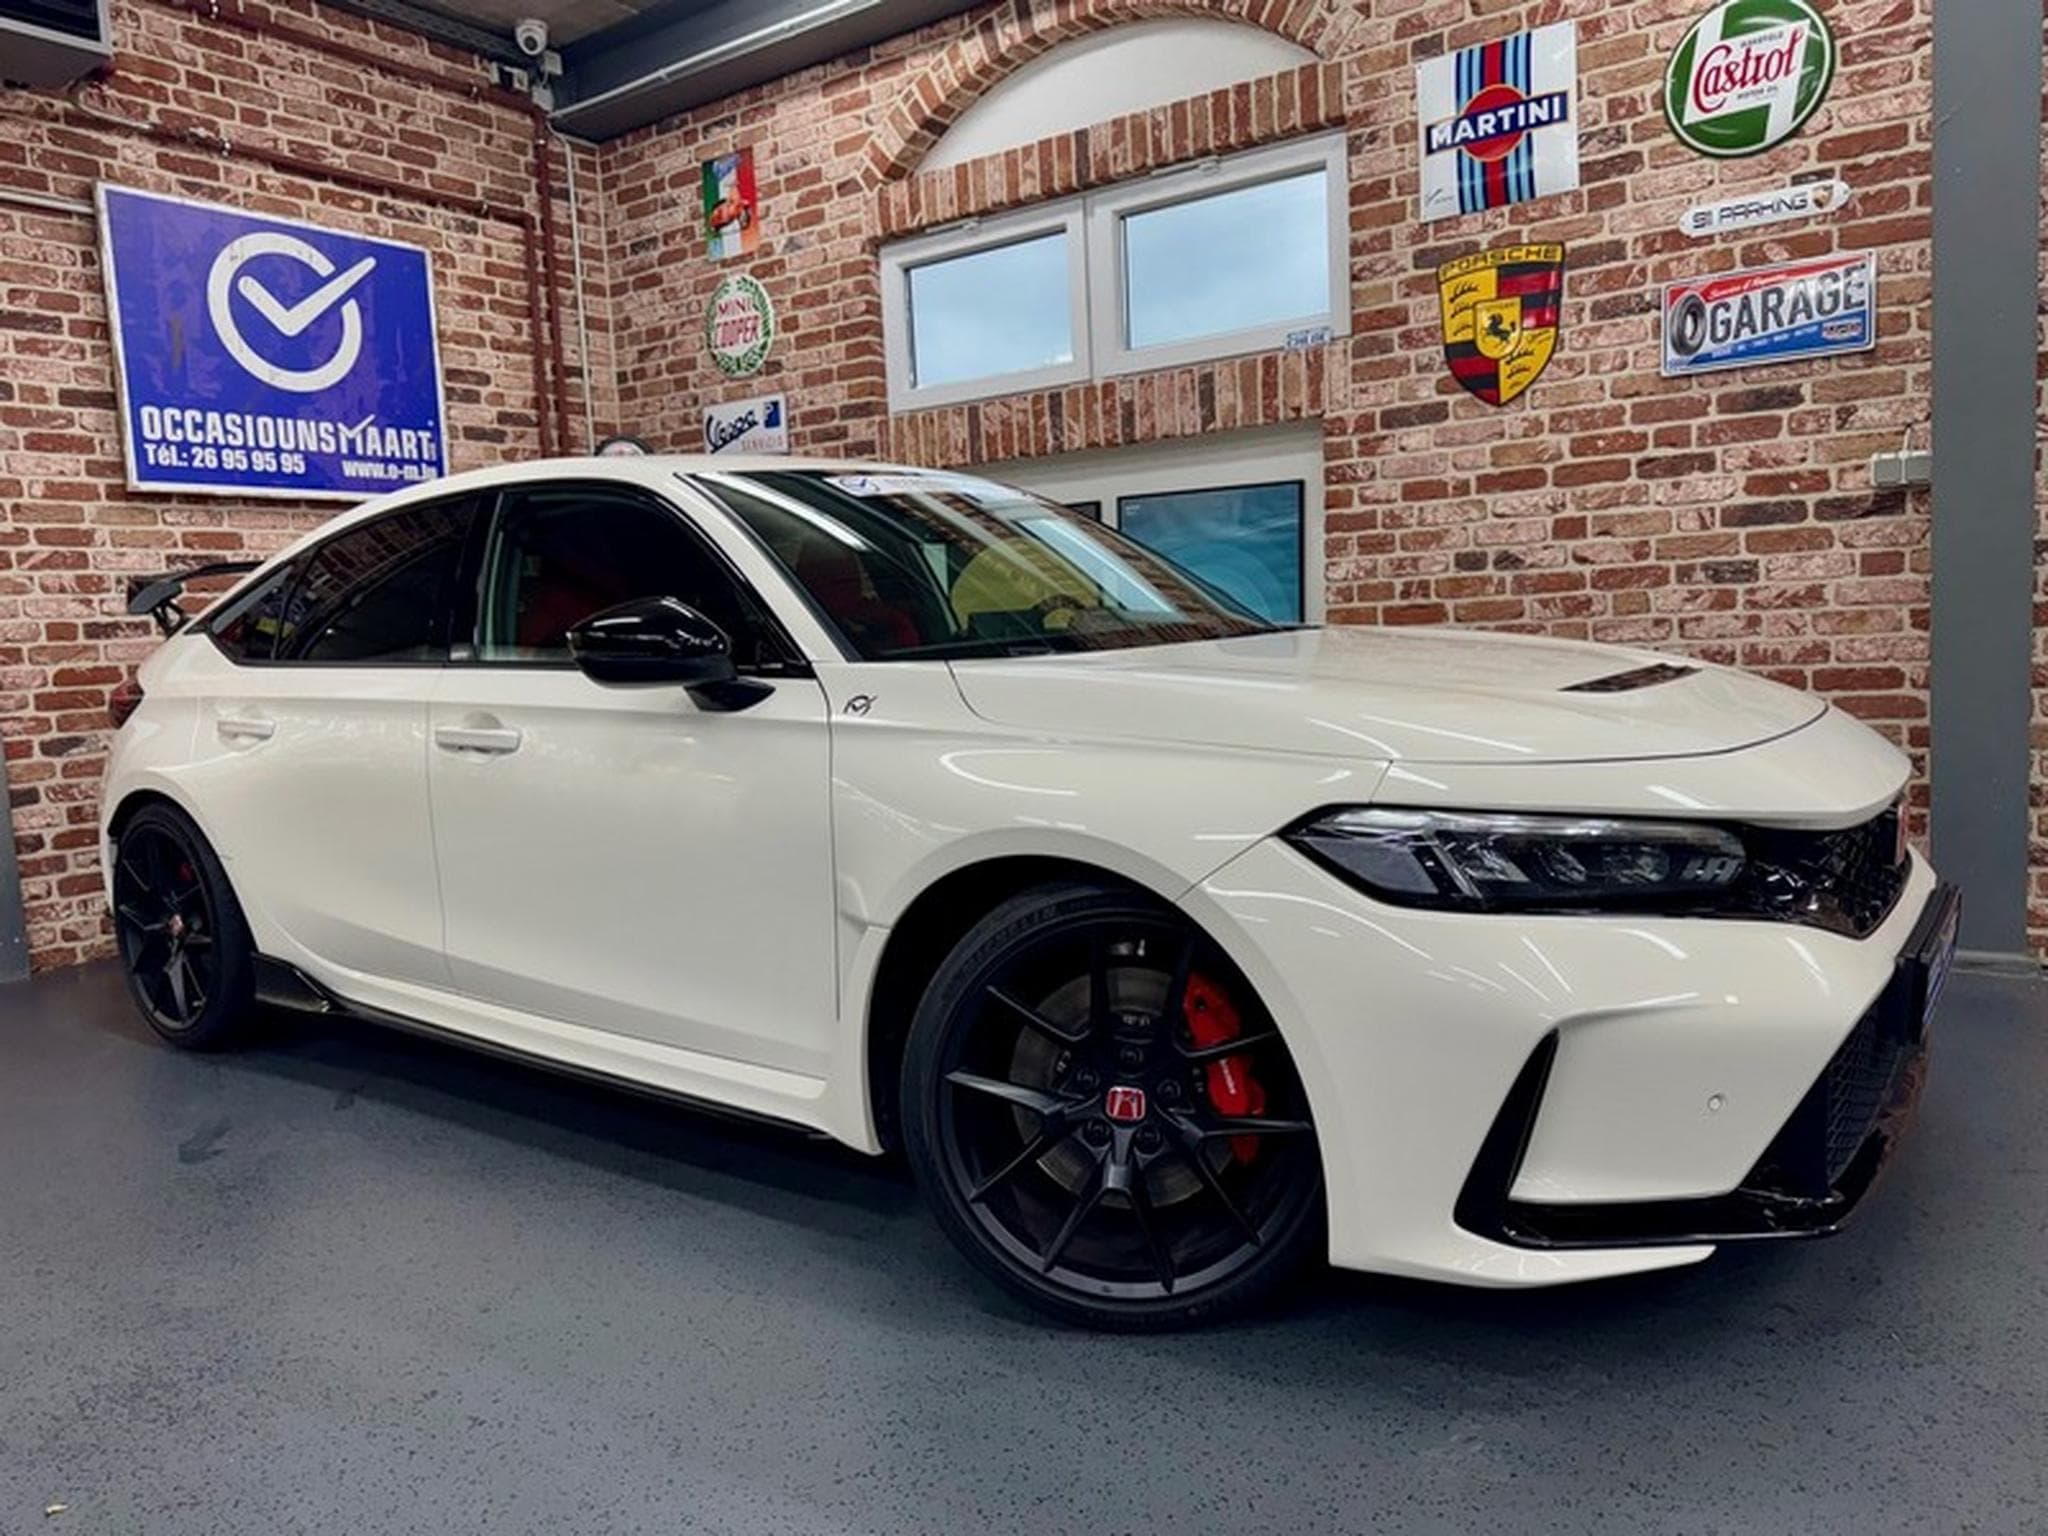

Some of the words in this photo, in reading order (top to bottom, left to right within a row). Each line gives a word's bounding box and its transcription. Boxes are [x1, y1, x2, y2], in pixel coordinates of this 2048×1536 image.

[1693, 26, 1804, 114] Castrol
[1430, 95, 1561, 150] MARTINI
[1719, 191, 1809, 224] PARKING
[1441, 246, 1559, 278] PORSCHE
[1709, 262, 1867, 345] GARAGE
[139, 404, 433, 461] OCCASIOUNSMAART
[191, 445, 219, 469] 26
[221, 448, 249, 471] 95
[251, 450, 278, 473] 95
[280, 452, 306, 475] 95
